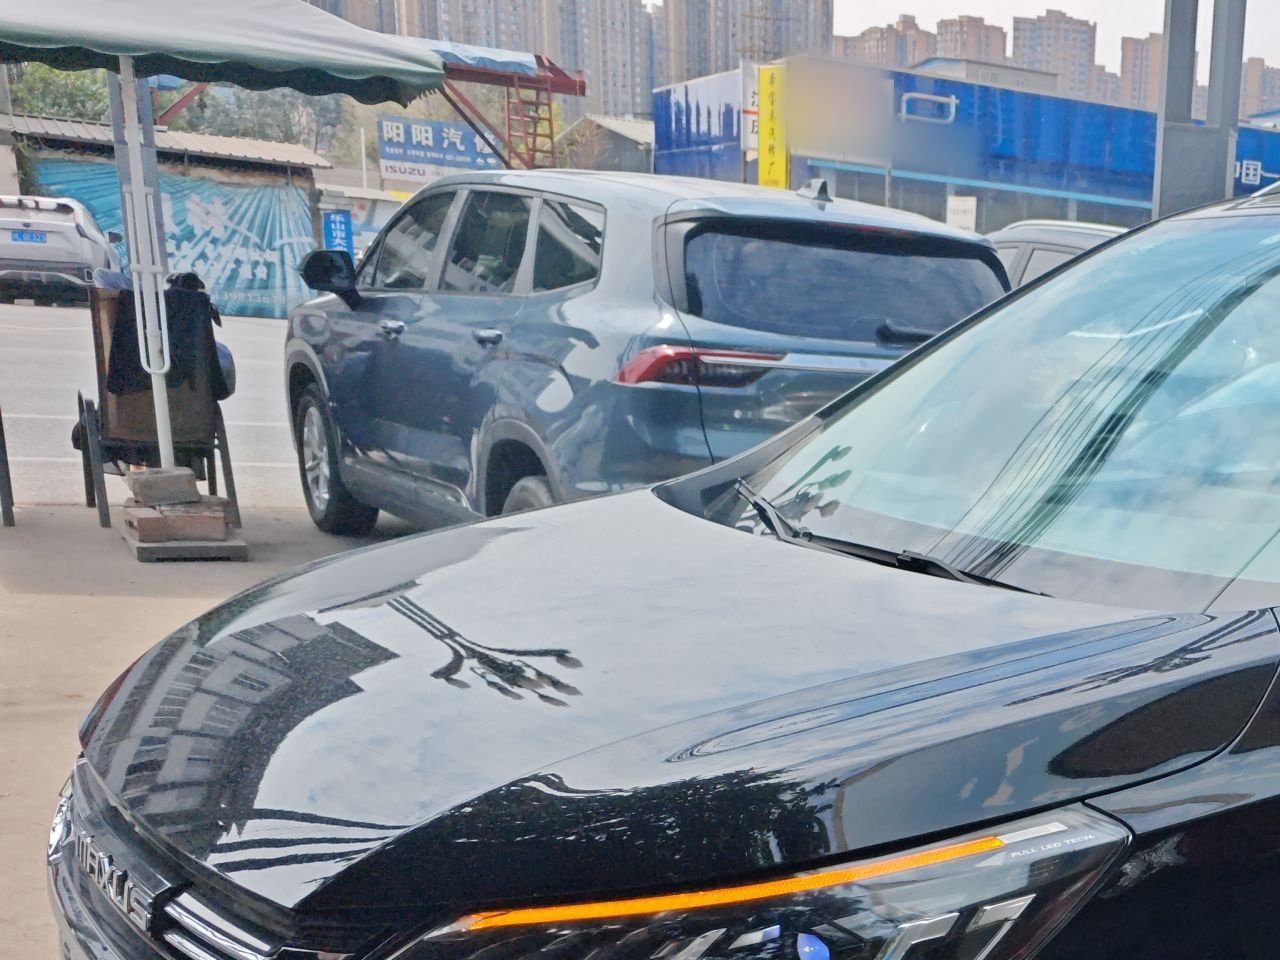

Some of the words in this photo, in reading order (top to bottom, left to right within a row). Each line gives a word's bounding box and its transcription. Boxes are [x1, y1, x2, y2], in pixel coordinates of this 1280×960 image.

[382, 120, 497, 154] 阳阳汽修
[385, 164, 426, 177] ISUZU
[1010, 848, 1038, 858] FULL
[1040, 841, 1062, 851] LED
[75, 831, 152, 931] MAXUS
